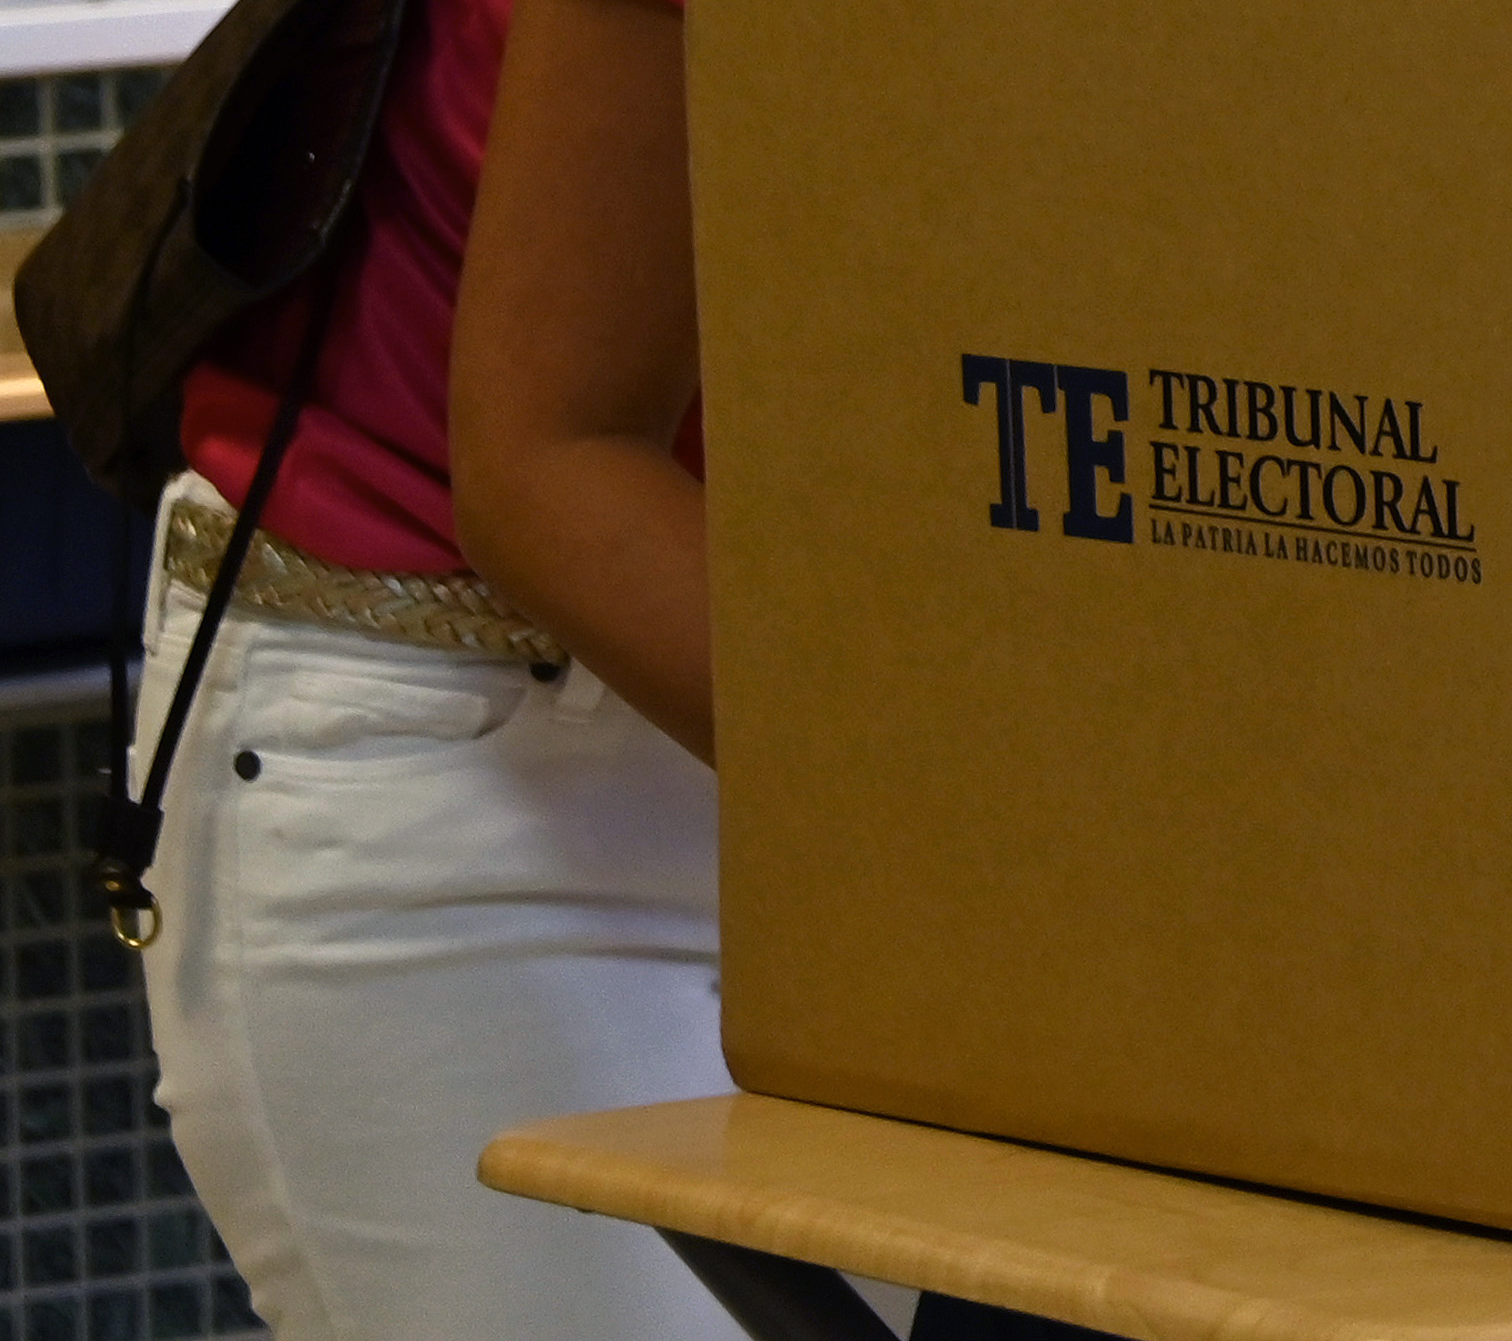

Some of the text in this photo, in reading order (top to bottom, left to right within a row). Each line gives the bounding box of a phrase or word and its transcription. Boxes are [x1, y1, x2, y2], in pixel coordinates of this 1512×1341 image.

[960, 353, 1134, 545] TE
[1149, 368, 1438, 464] TRIBUNAL
[1150, 441, 1475, 543] ELECTORAL
[1151, 518, 1482, 585] LA PATRIA LA HACEMOS TODOS
